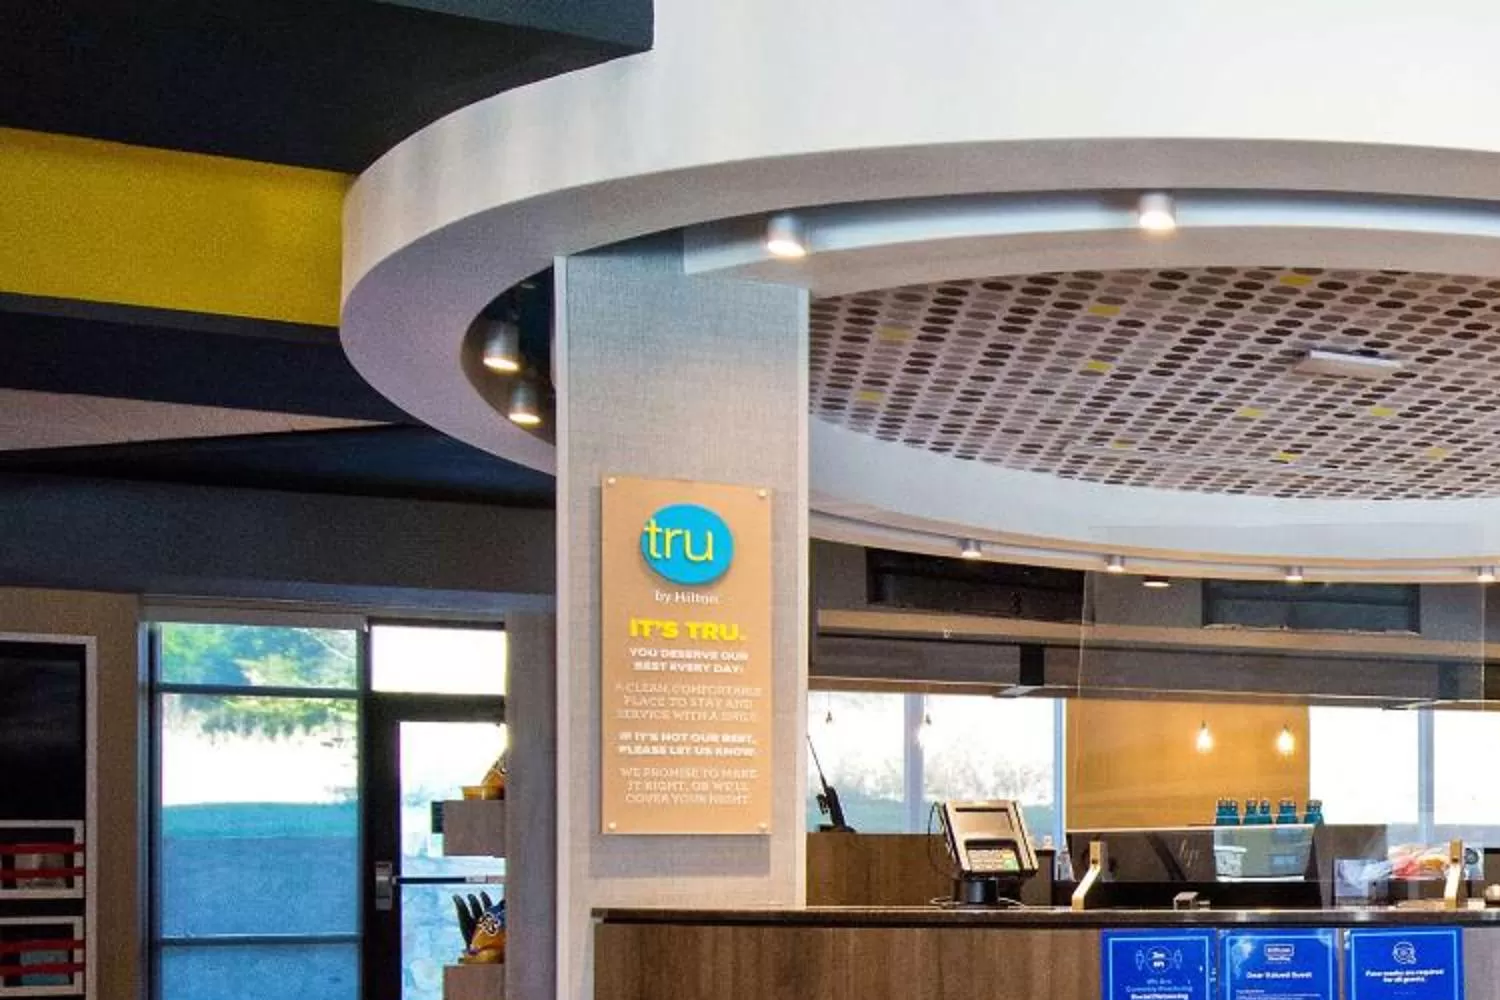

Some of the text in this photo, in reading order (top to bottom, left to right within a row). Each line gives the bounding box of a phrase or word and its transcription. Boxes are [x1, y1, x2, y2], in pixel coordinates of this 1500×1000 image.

[644, 519, 713, 562] tru
[655, 589, 719, 604] by Hilton
[630, 618, 746, 640] IT'S TRU.
[630, 648, 656, 657] YOU
